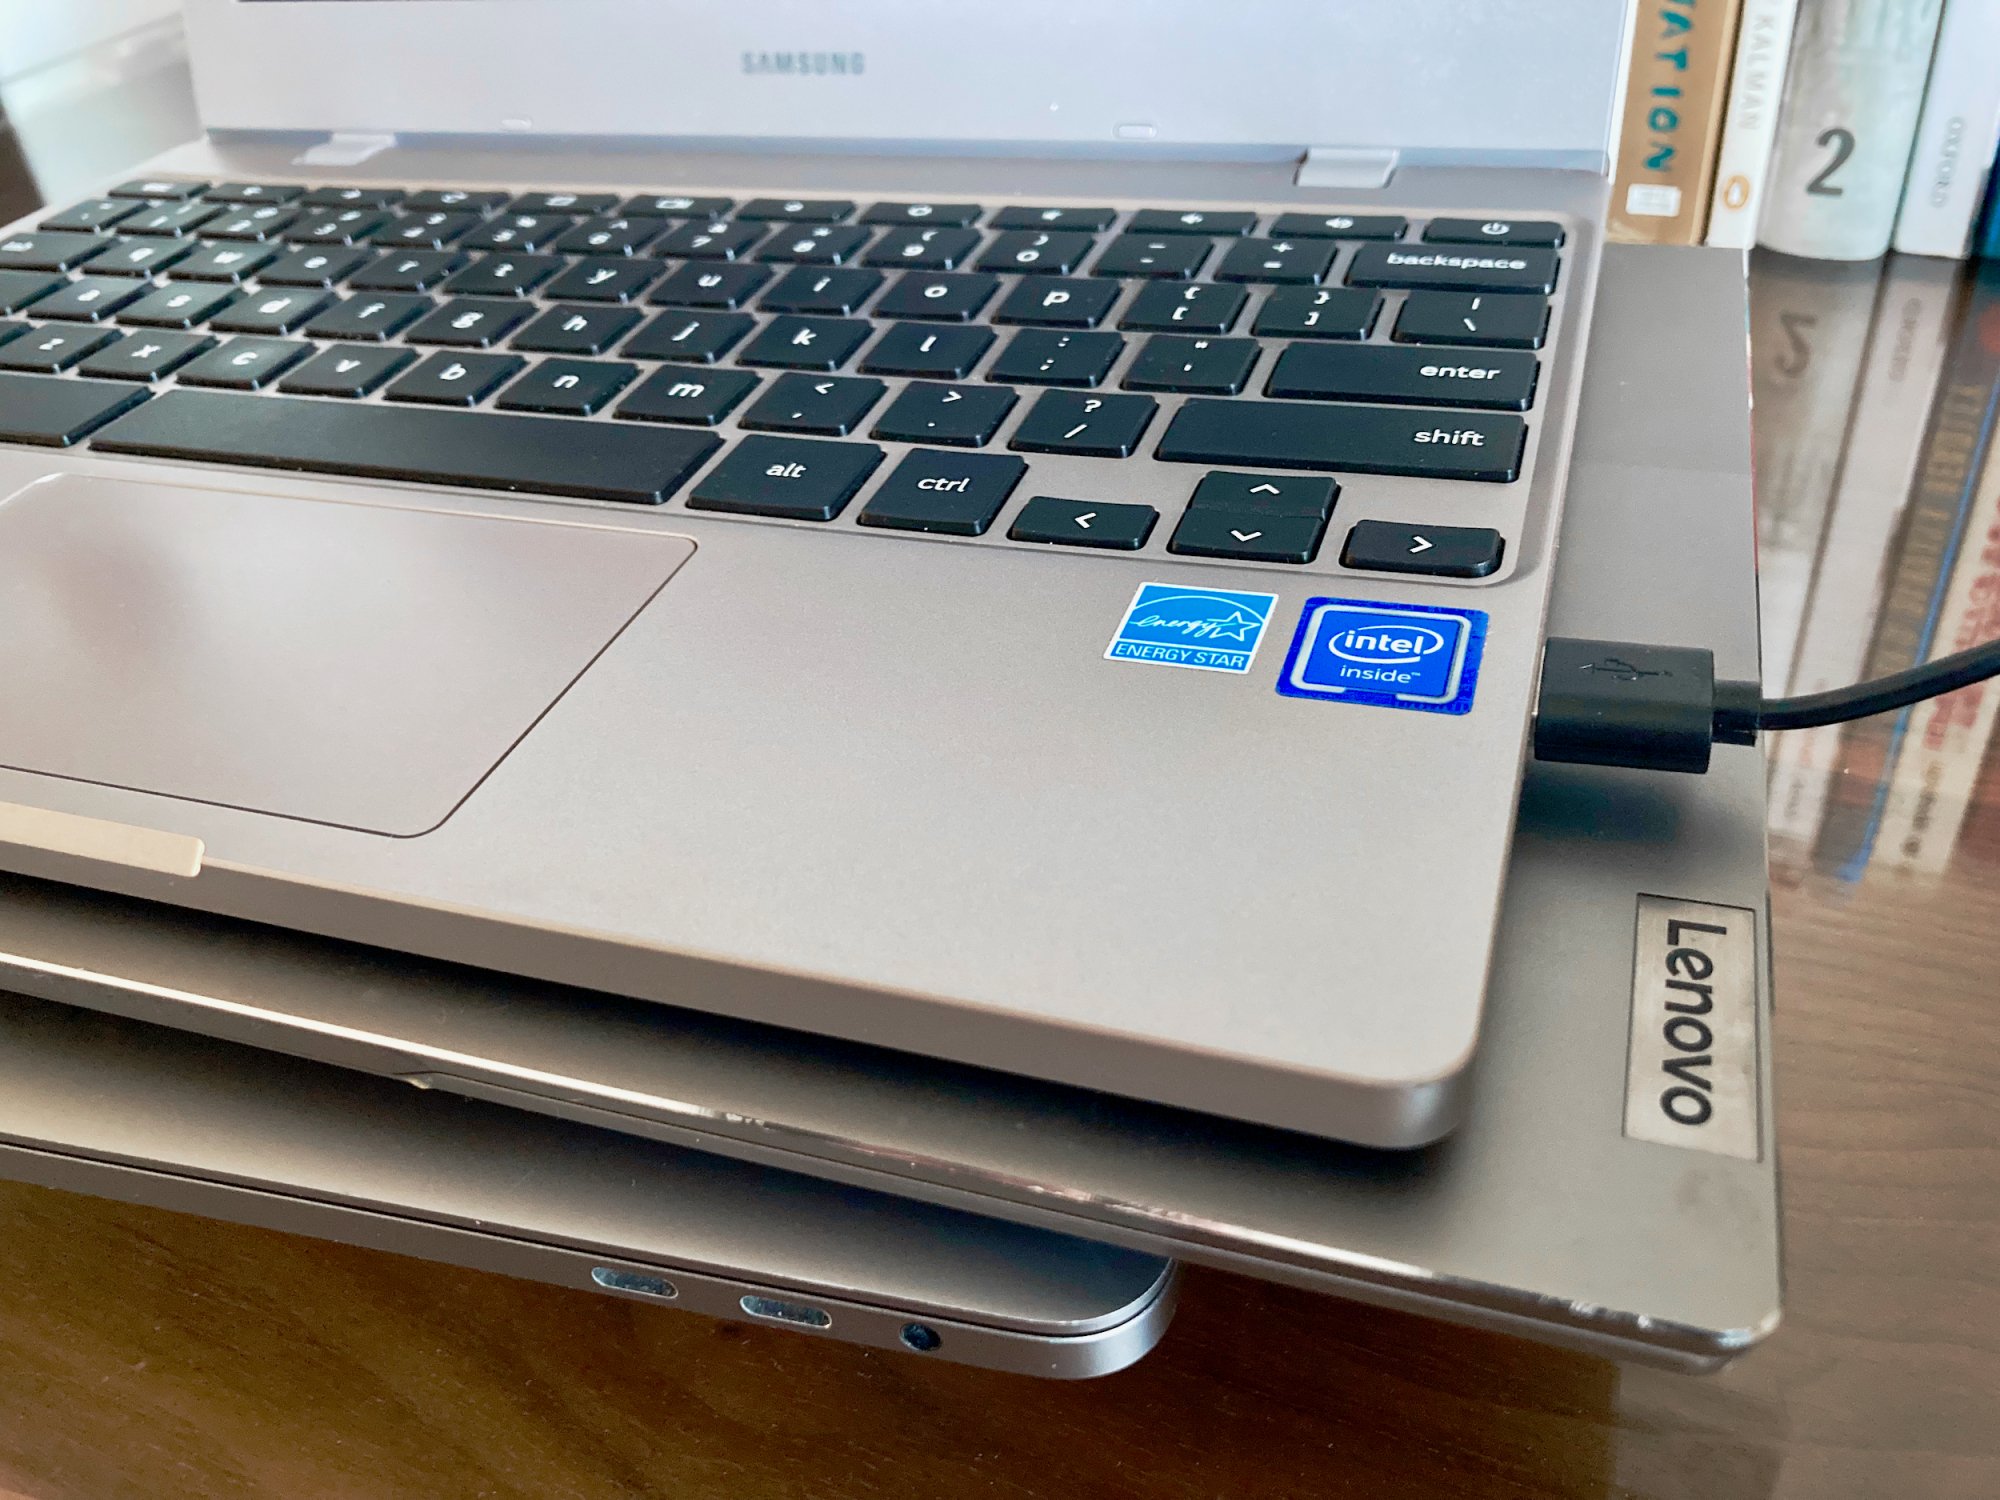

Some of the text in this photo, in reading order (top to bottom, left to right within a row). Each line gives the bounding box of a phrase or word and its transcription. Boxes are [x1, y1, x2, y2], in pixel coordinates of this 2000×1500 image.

[742, 51, 865, 75] SAMSUNG
[1737, 13, 1776, 130] KALMAN
[1641, 0, 1696, 172] ATION
[1806, 127, 1856, 197] 2
[1386, 252, 1527, 270] backspace
[587, 268, 617, 285] y
[698, 274, 722, 287] u
[924, 285, 948, 298] o
[1042, 291, 1070, 307] p
[1171, 306, 1189, 321] [
[1304, 311, 1320, 326] ]
[563, 315, 588, 331] h
[792, 328, 817, 346] k
[131, 344, 161, 358] x
[231, 351, 260, 366] c
[335, 359, 361, 373] v
[439, 363, 467, 381] b
[1419, 365, 1501, 380] enter
[553, 375, 580, 389] n
[668, 383, 705, 398] m
[1084, 399, 1102, 413] ?
[1063, 423, 1088, 439] /
[1413, 428, 1485, 446] shift
[765, 462, 807, 478] alt
[917, 477, 970, 493] ctrl
[1129, 615, 1218, 638] energy
[1344, 630, 1425, 655] intel
[1115, 643, 1246, 668] ENERGY STAR
[1659, 918, 1728, 1126] Lenovo
